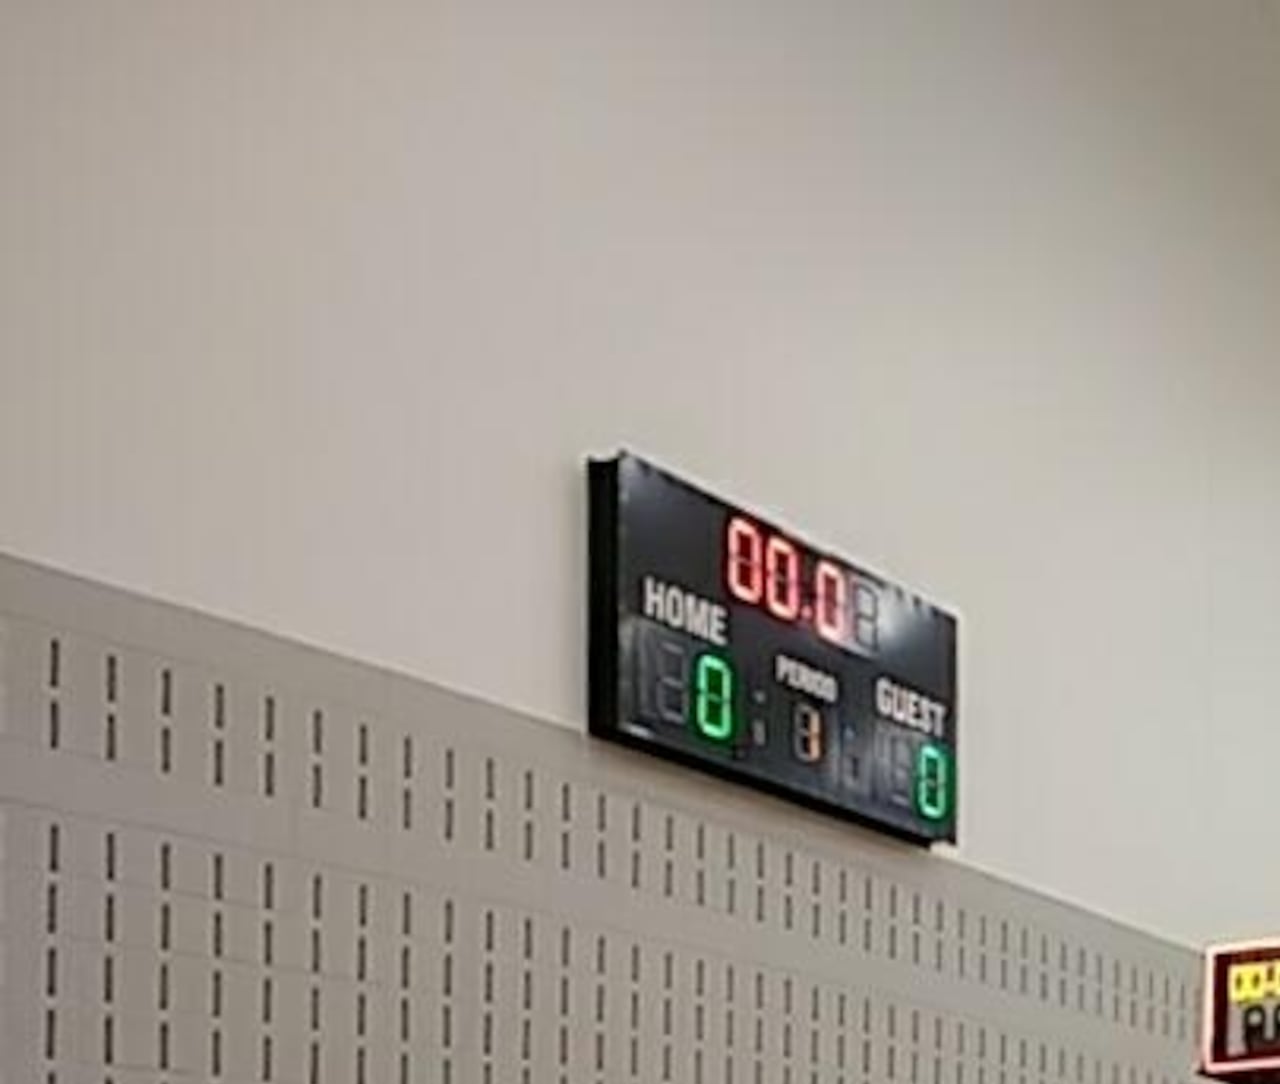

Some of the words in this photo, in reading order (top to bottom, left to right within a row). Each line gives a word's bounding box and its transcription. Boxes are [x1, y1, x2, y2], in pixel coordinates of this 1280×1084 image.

[642, 575, 729, 646] HOME
[696, 653, 733, 741] 0
[875, 676, 948, 737] GUEST
[916, 742, 947, 820] 0
